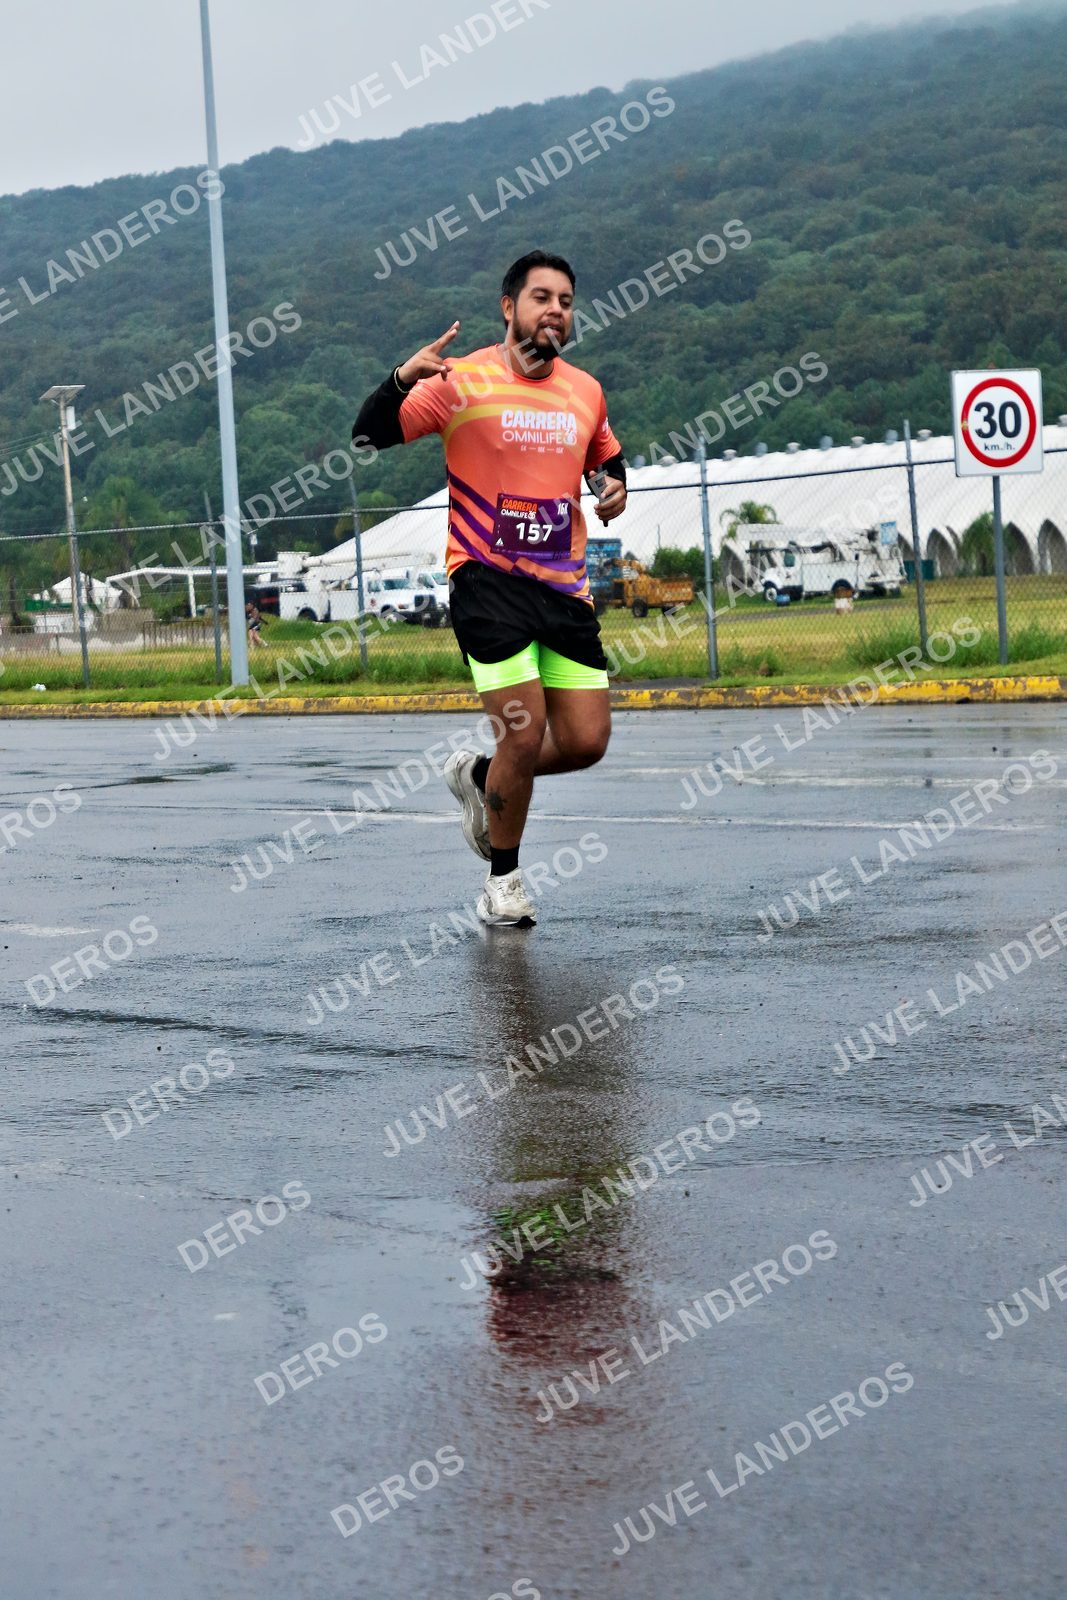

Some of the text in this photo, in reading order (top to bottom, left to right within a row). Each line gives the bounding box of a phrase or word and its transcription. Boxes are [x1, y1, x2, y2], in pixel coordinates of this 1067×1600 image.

[501, 410, 577, 433] CARRERA
[974, 401, 1022, 438] 30
[502, 498, 538, 512] CARRERA
[557, 502, 569, 516] 16K
[515, 522, 553, 542] 157
